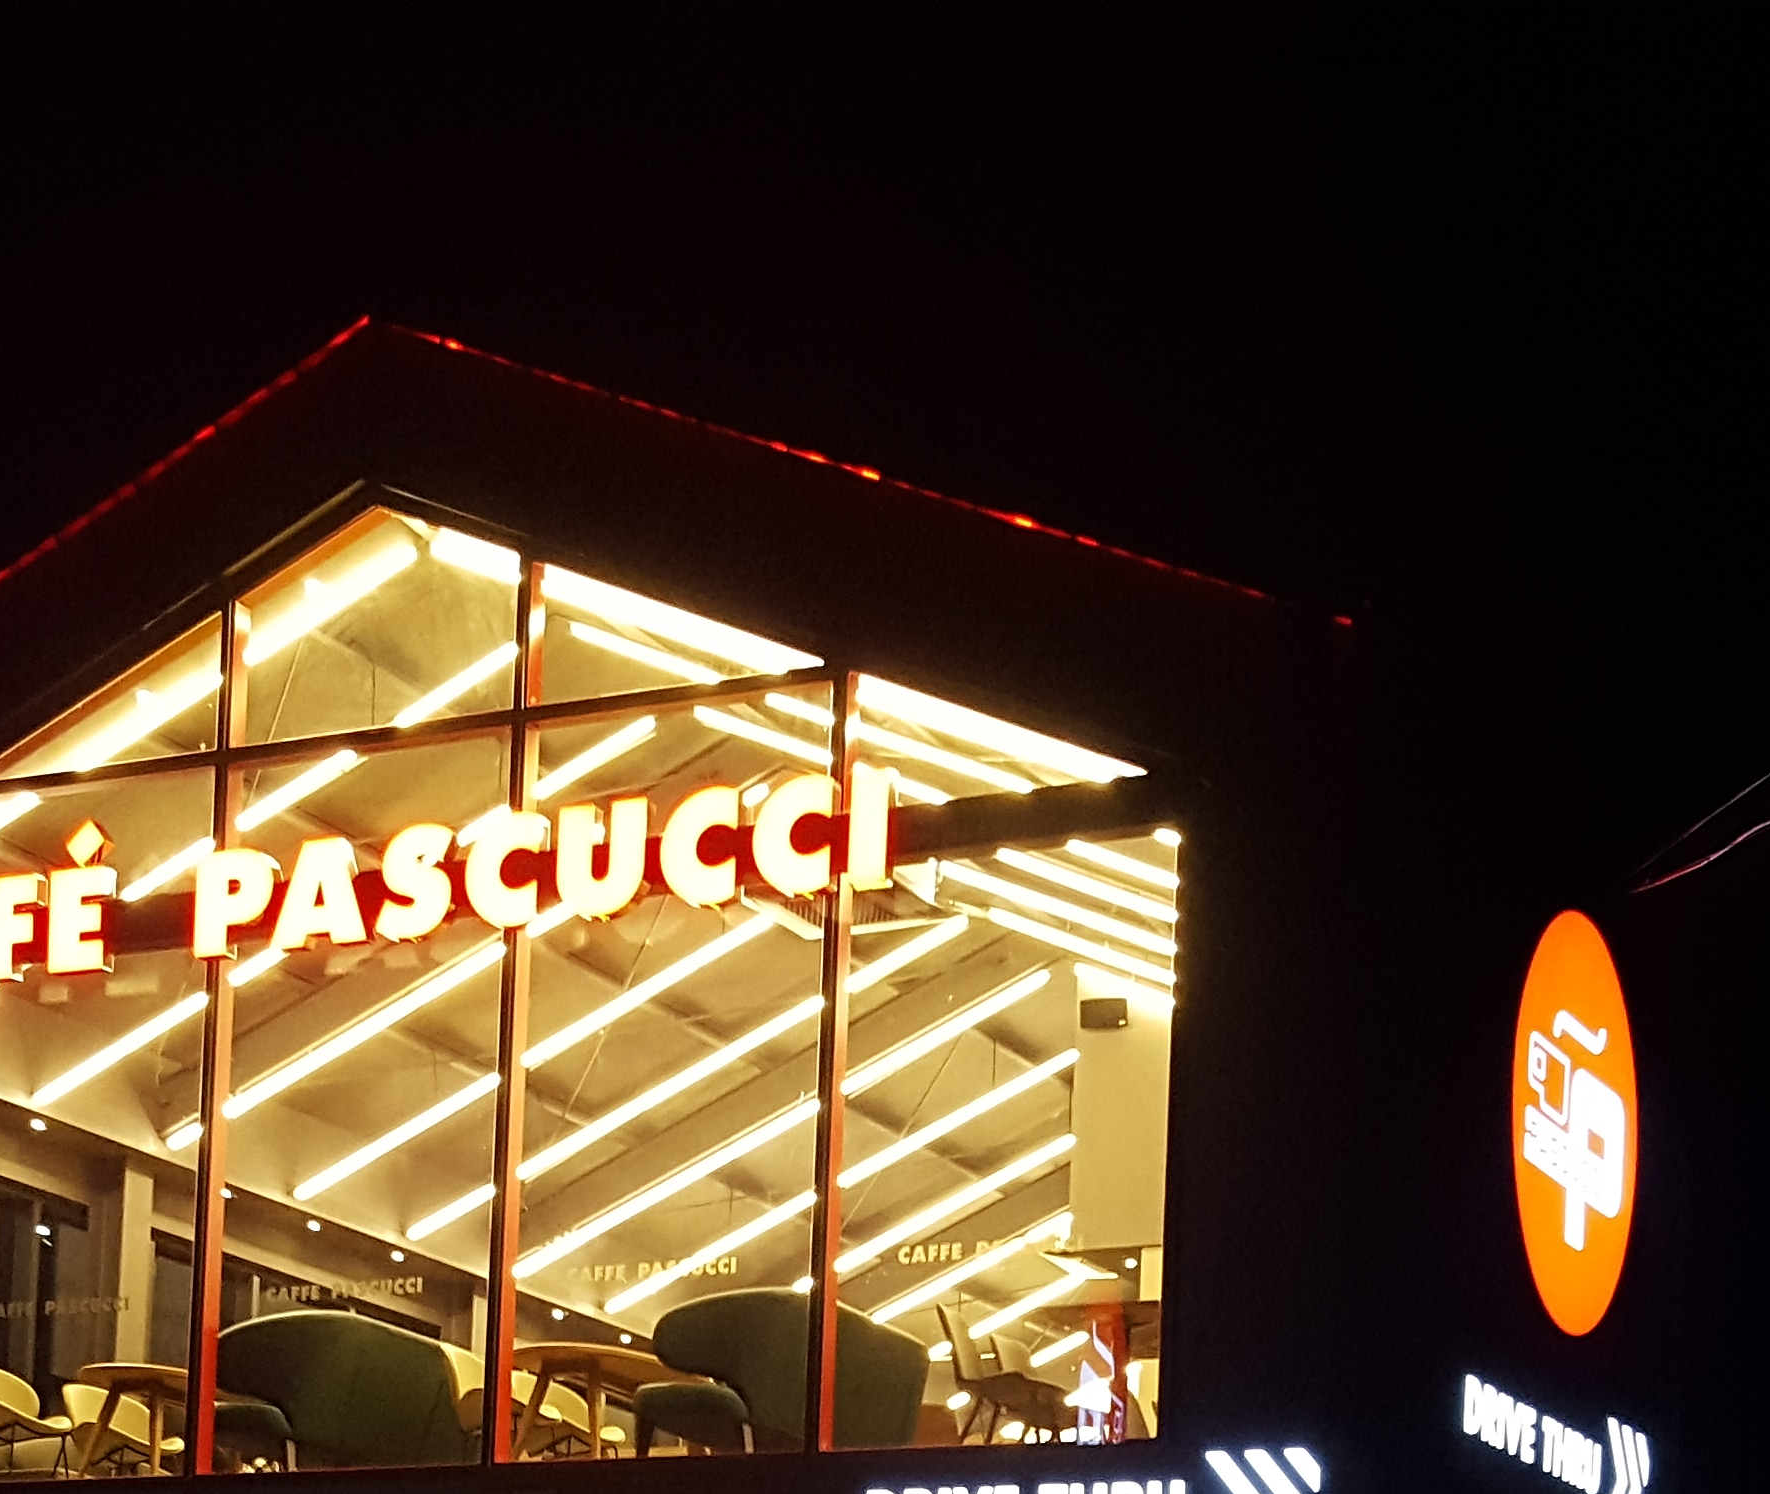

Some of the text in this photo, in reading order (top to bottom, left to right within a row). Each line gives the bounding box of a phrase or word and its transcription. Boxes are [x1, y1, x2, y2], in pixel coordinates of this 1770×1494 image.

[191, 762, 897, 961] PASCUCCI
[637, 1256, 738, 1279] PASUCCI
[1463, 1373, 1537, 1465] DRIVE
